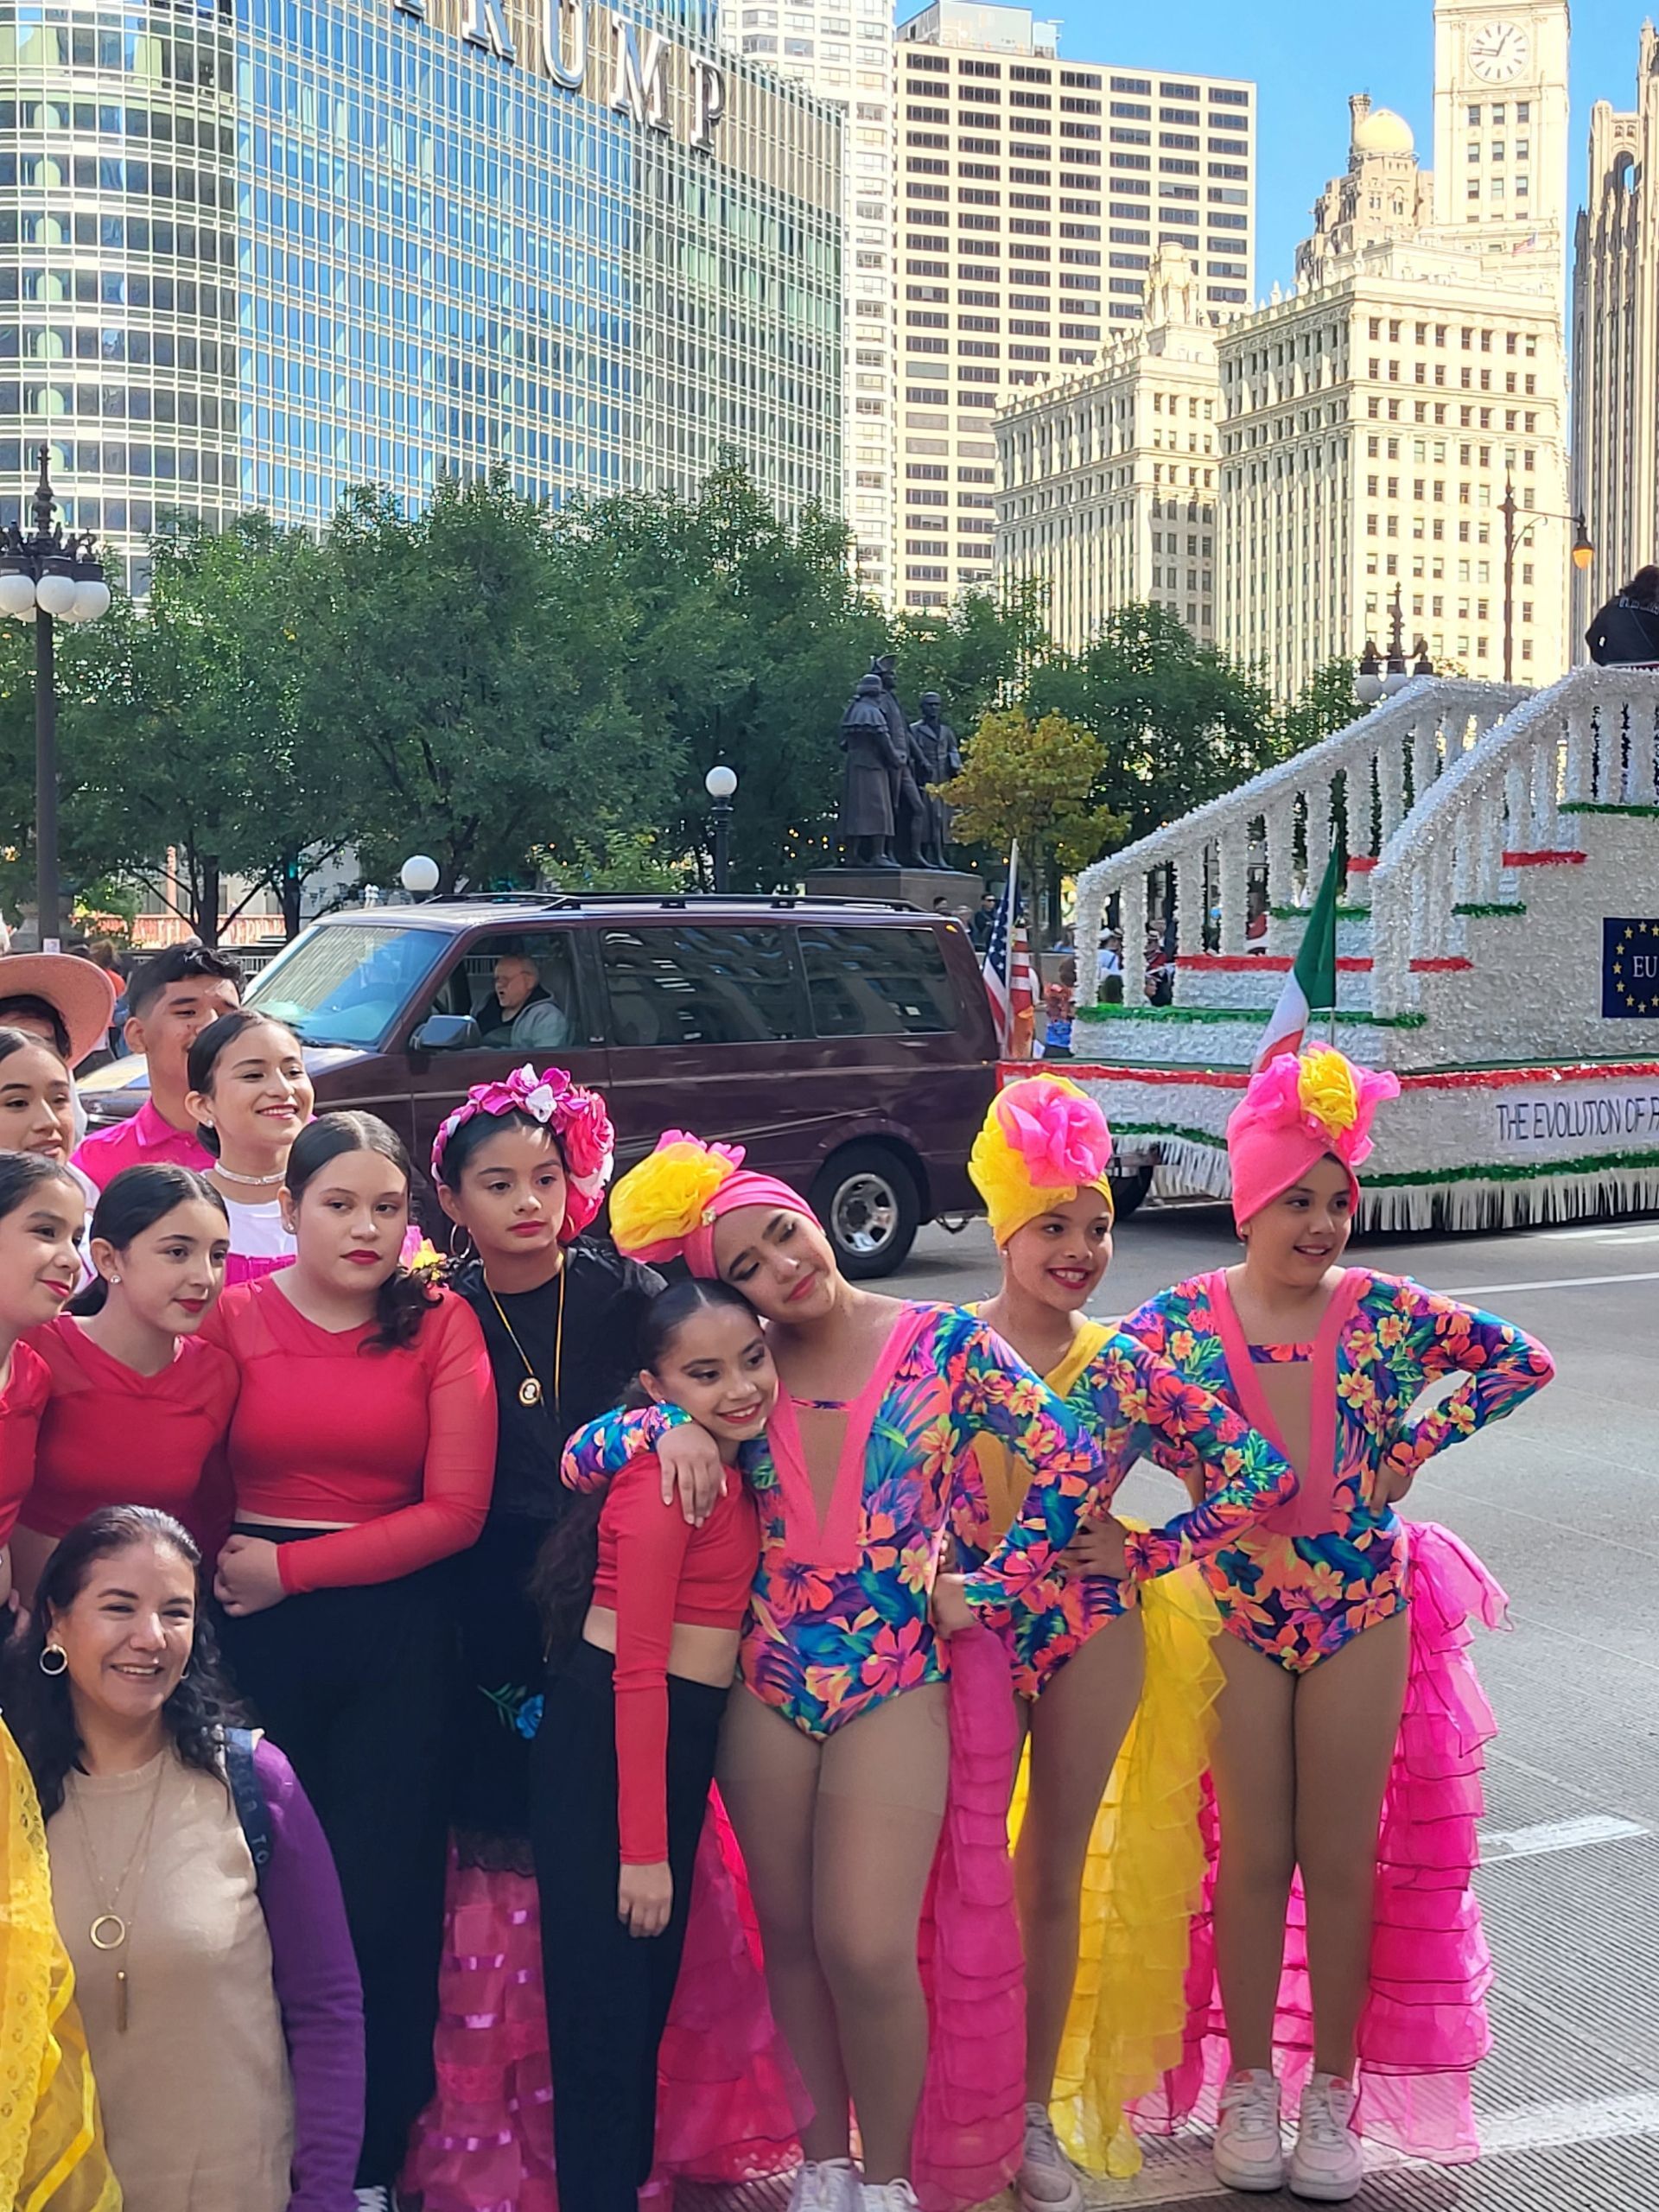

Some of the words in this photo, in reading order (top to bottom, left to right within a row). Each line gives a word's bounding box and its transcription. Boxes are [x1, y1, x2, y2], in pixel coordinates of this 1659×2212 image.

[394, 0, 726, 154] UMP
[1632, 955, 1658, 978] EU
[1496, 1103, 1529, 1141] THE
[1533, 1098, 1621, 1139] EVOLUTION
[1624, 1097, 1646, 1134] OF
